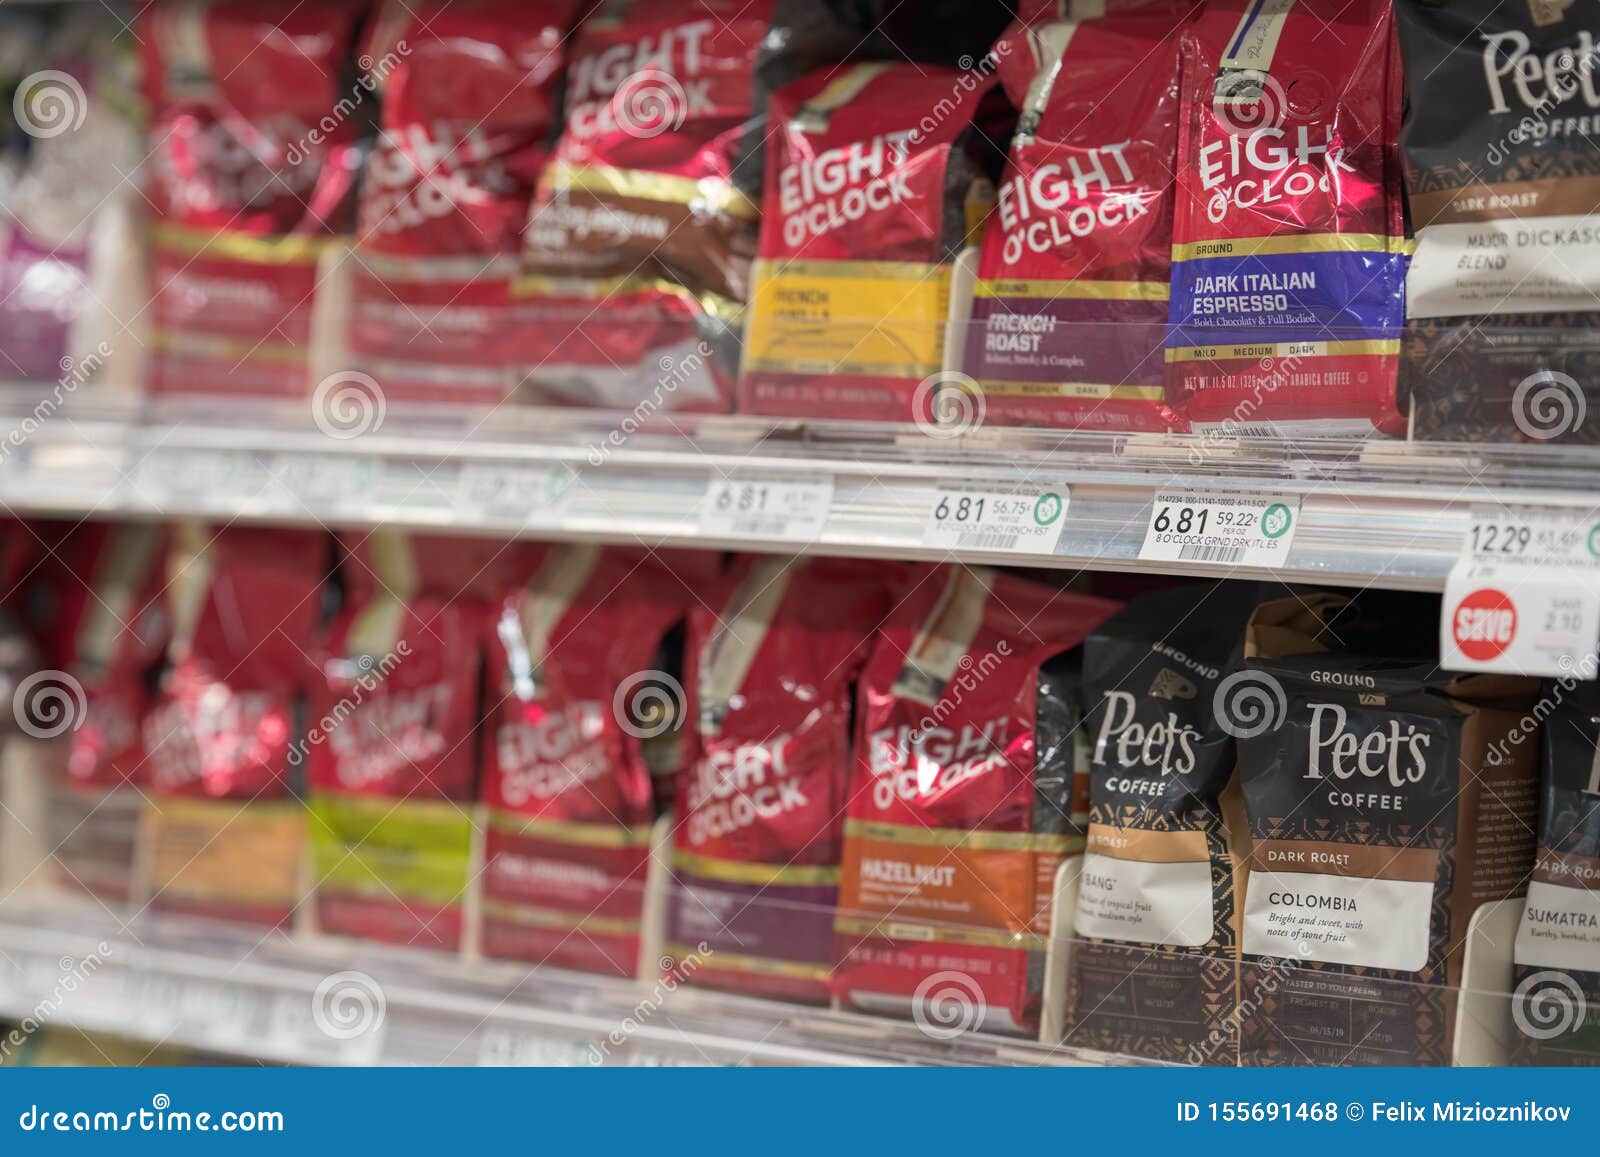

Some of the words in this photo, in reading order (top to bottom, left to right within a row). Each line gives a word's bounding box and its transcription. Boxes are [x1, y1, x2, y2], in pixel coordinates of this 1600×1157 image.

[779, 128, 918, 215] EIGHT
[999, 139, 1131, 231] EIGHT
[783, 170, 913, 247] O'CLOCK
[1453, 197, 1485, 212] DARK
[1488, 192, 1539, 209] ROAST
[1003, 187, 1148, 265] O'CLOCK
[1196, 244, 1233, 256] GROUND
[1467, 232, 1508, 249] MAJOR
[1194, 275, 1239, 294] DARK
[1243, 272, 1316, 292] ITALIAN
[1193, 294, 1288, 315] ESPRESSO
[987, 313, 1056, 332] FRENCH
[1259, 317, 1265, 325] &
[1268, 315, 1284, 325] Full
[1286, 313, 1316, 324] Bodied
[985, 332, 1041, 352] ROAST
[1194, 348, 1216, 358] MILD
[1233, 346, 1273, 357] MEDIUM
[1289, 345, 1316, 354] DARK
[1290, 373, 1321, 386] ARABICA
[1323, 372, 1349, 385] COFFEE
[1154, 507, 1208, 534] 6.81
[1163, 535, 1203, 545] O'CLOCK
[1204, 536, 1231, 546] GRND
[1457, 606, 1514, 643] save
[1152, 641, 1220, 681] GROUND
[1311, 670, 1375, 689] GROUND
[1091, 690, 1205, 777] Peet's
[1303, 703, 1431, 787] Peet's
[1105, 777, 1166, 796] COFFEE
[1328, 791, 1403, 811] COFFEE
[1268, 850, 1305, 863] DARK
[1311, 852, 1350, 865] ROAST
[859, 858, 956, 887] HAZELNUT
[1268, 892, 1358, 912] COLOMBIA
[1267, 912, 1297, 926] Bright
[1297, 915, 1316, 926] and
[1318, 920, 1342, 928] sweet,
[1345, 920, 1364, 930] with
[1527, 907, 1598, 929] SUMATRA
[1266, 929, 1288, 937] notes
[1291, 927, 1302, 940] of
[1302, 929, 1325, 940] stone
[1324, 930, 1347, 945] fruit
